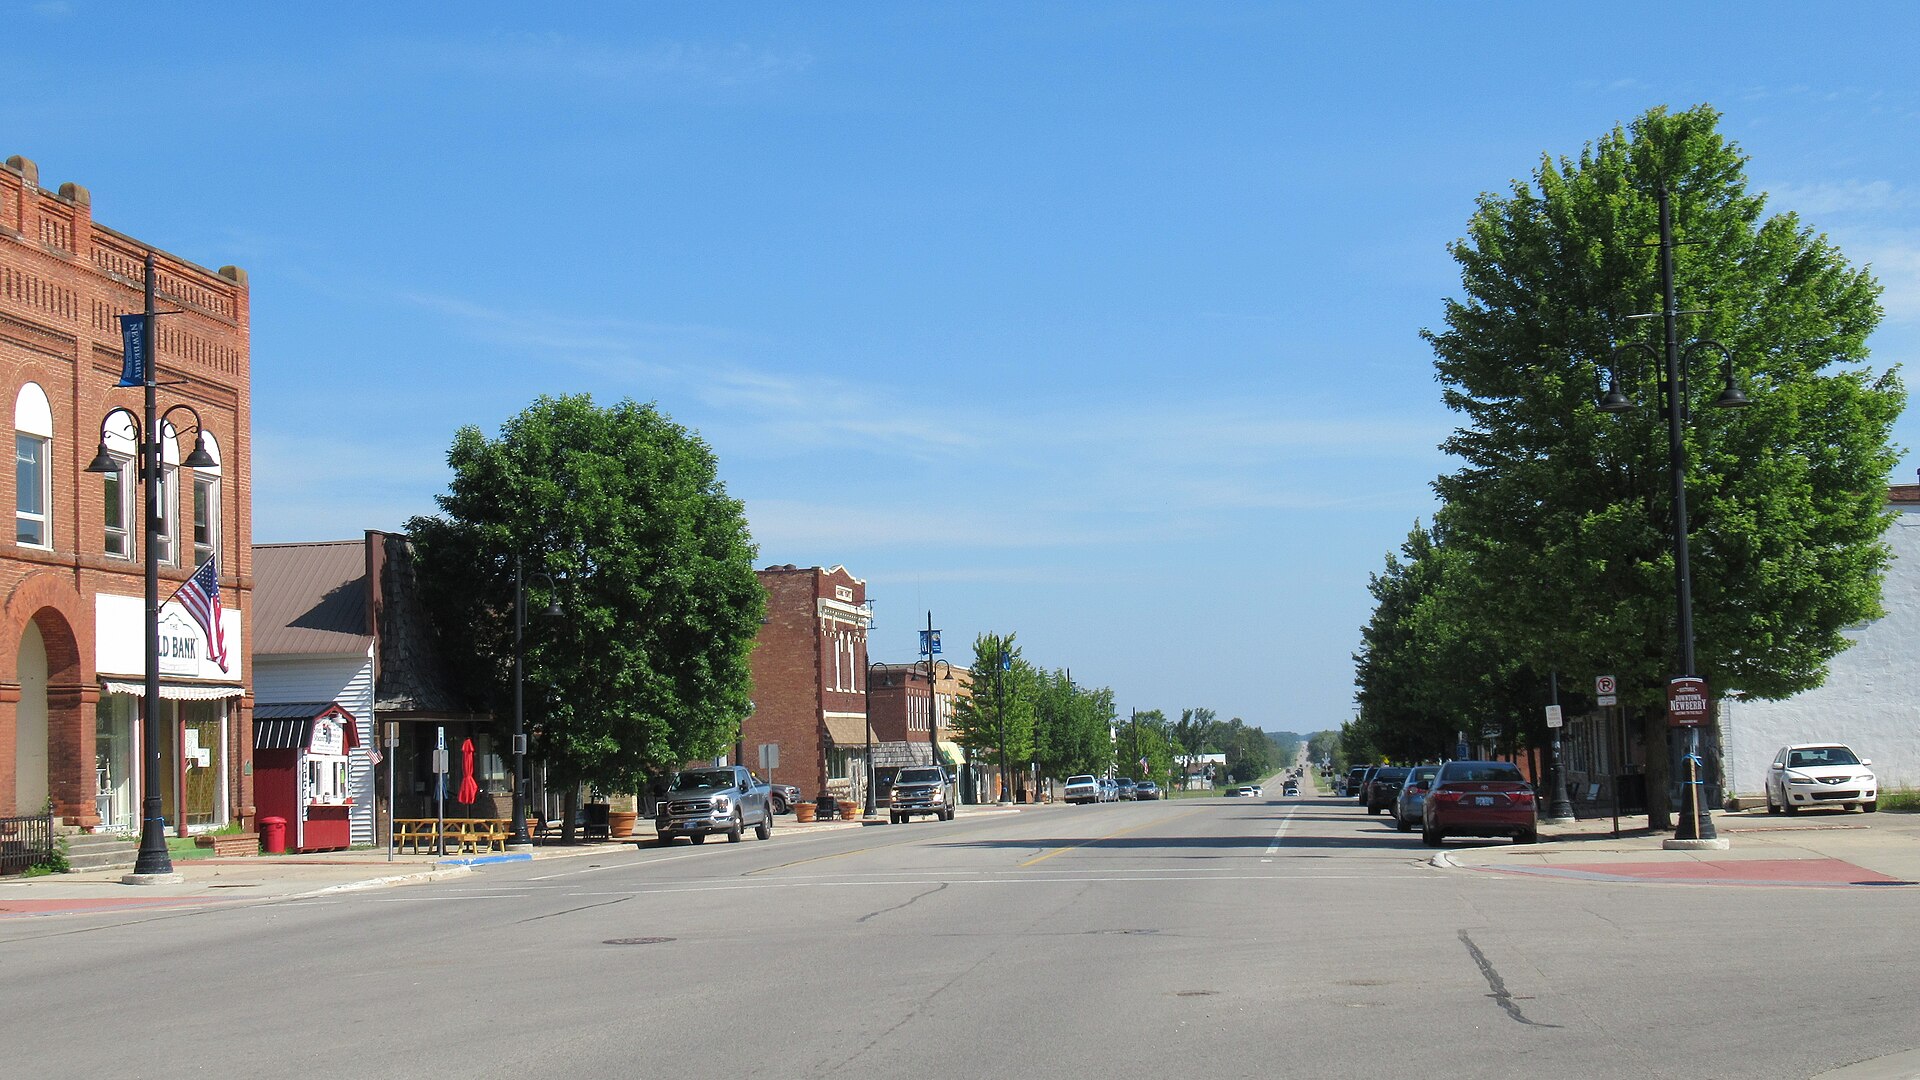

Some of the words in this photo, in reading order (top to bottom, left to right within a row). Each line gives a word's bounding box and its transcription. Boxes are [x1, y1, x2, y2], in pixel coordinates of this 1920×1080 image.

[130, 323, 141, 379] NEWBERRY
[157, 634, 170, 657] LD
[172, 636, 196, 660] BANK
[1670, 698, 1707, 711] NEWBERRY
